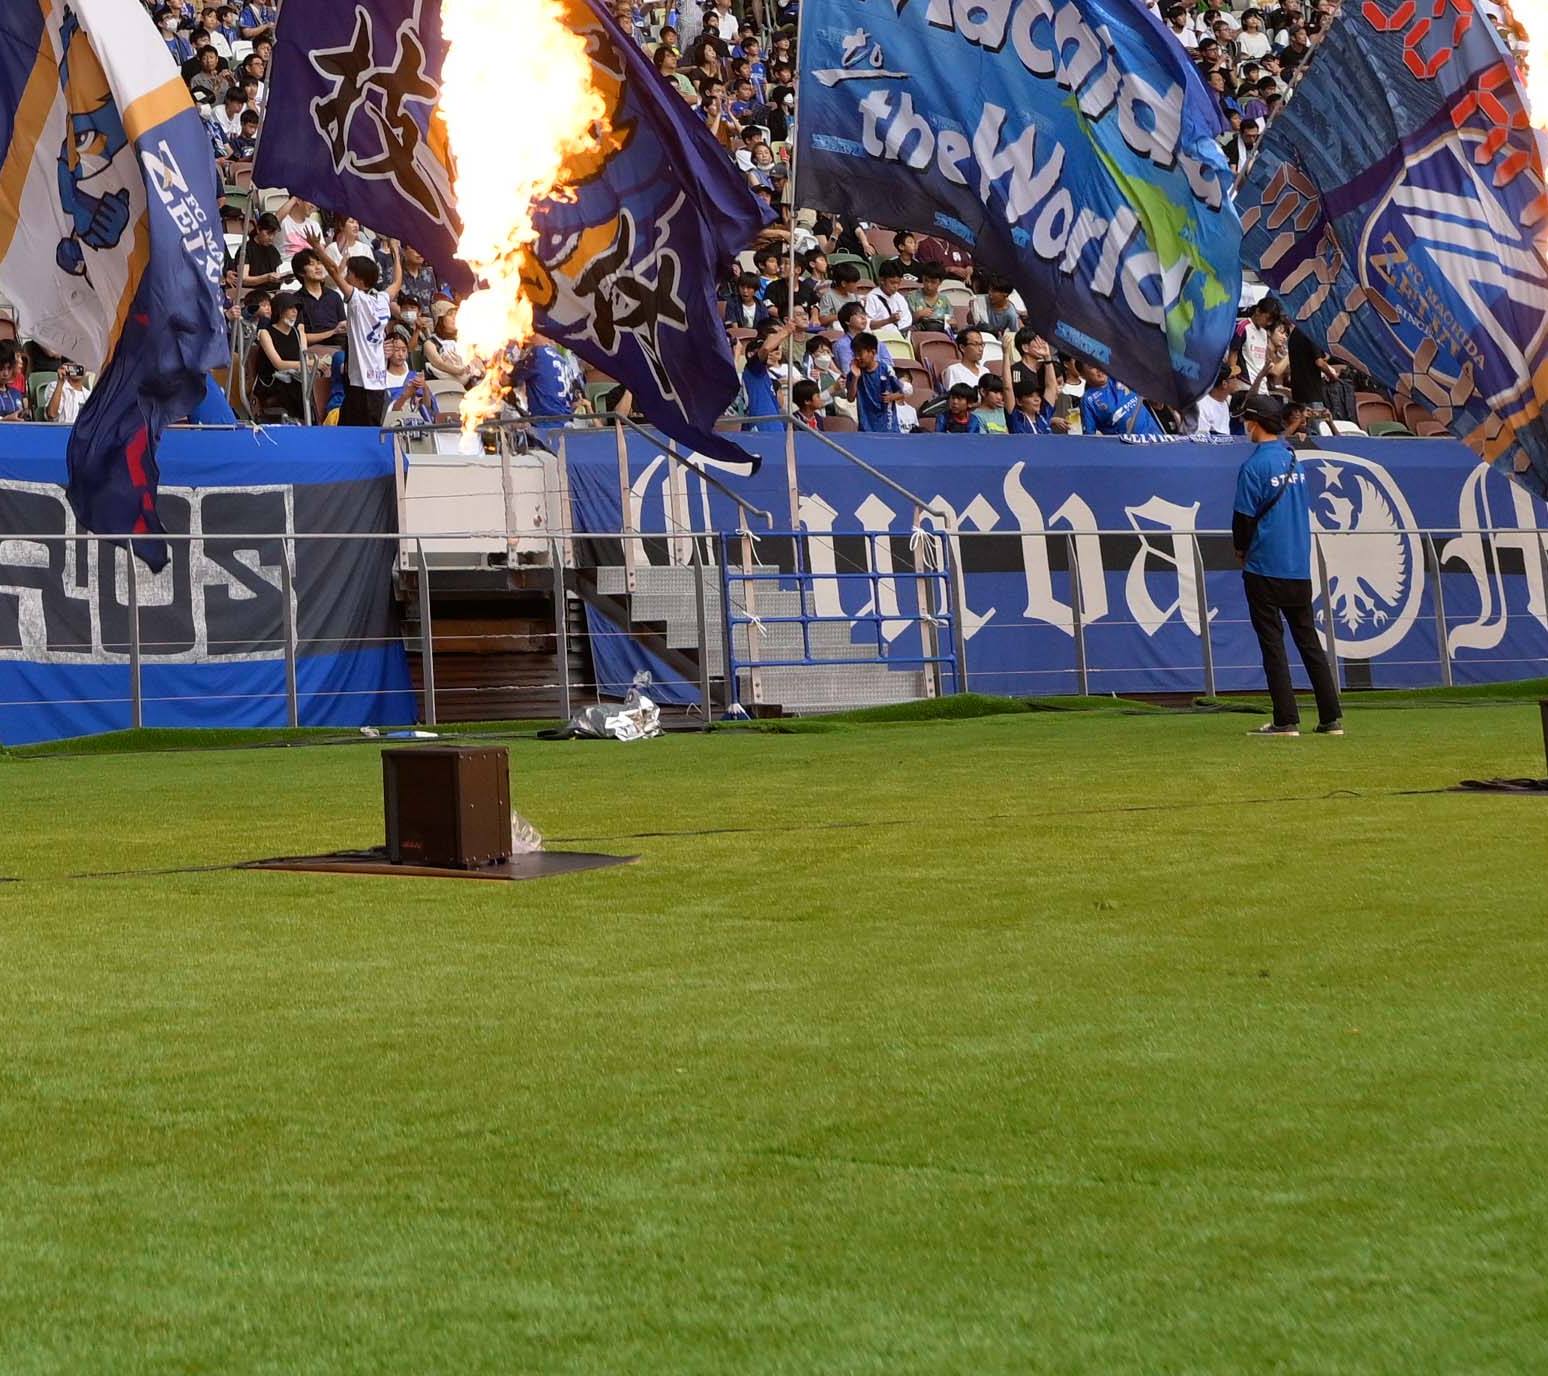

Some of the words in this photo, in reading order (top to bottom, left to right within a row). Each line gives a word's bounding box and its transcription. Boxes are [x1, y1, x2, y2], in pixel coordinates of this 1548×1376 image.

[842, 27, 884, 69] to
[858, 89, 976, 186] the
[972, 101, 1193, 332] World
[1424, 286, 1487, 372] MACHIDA
